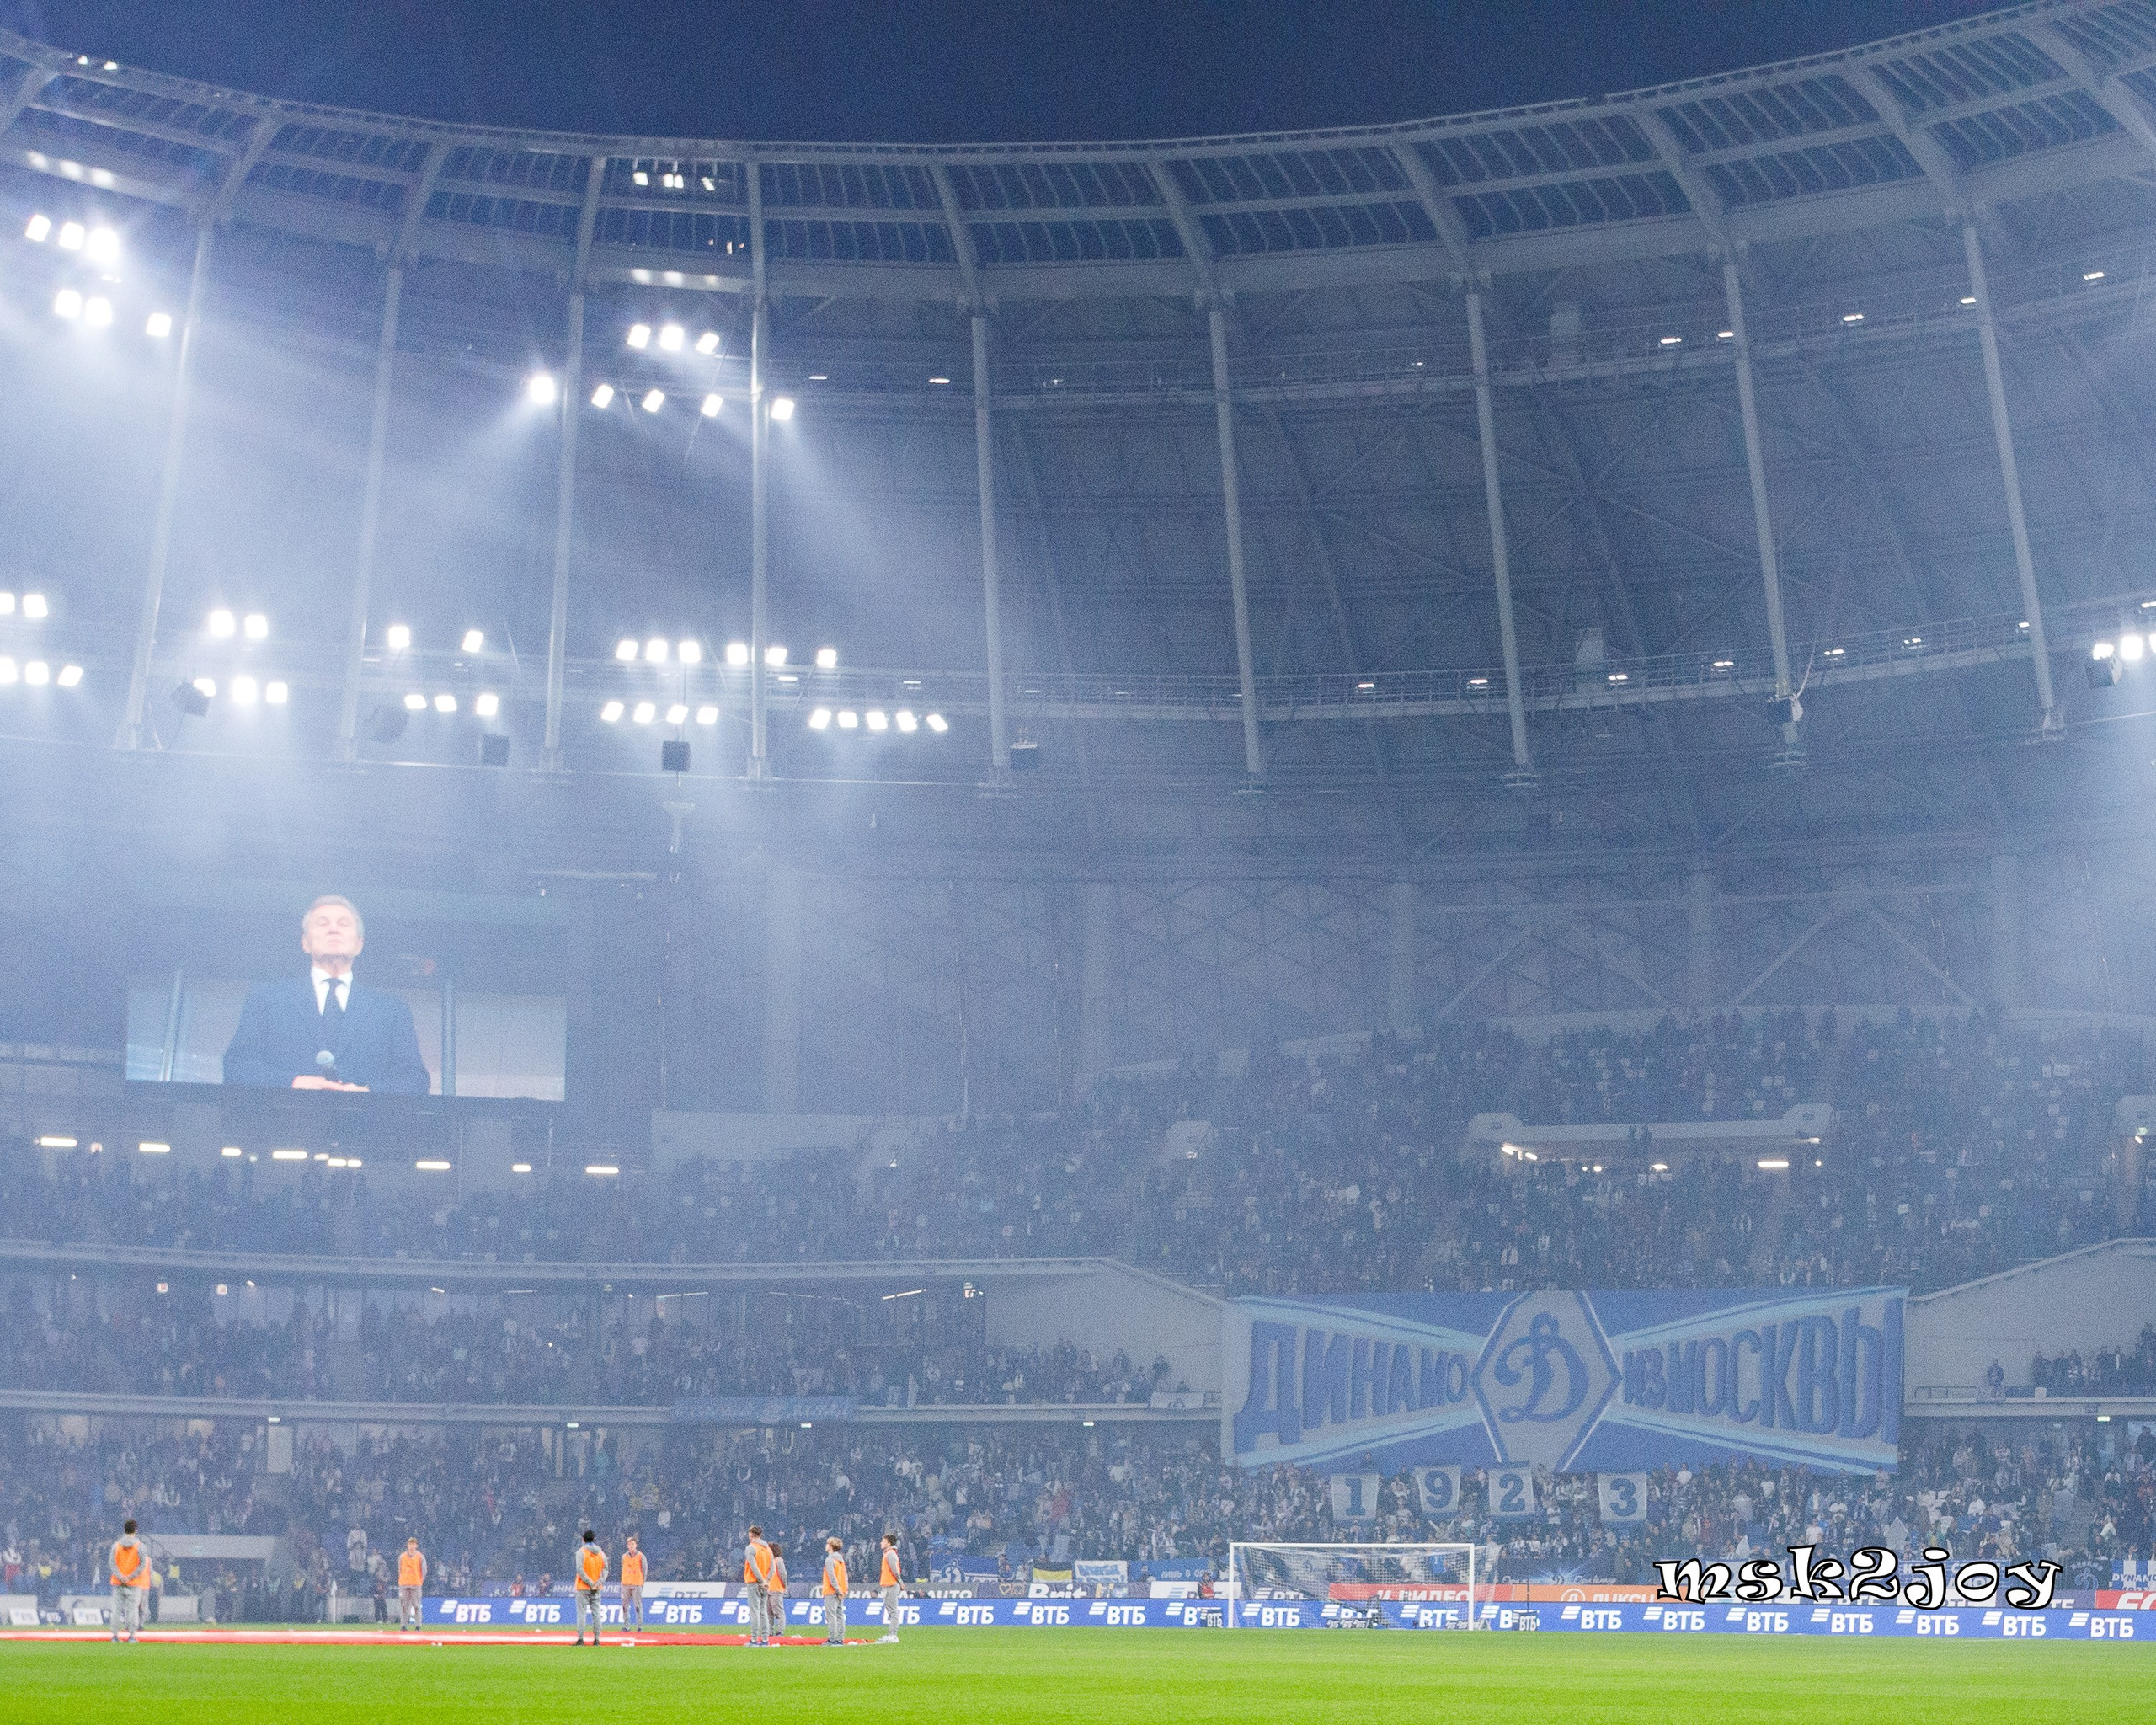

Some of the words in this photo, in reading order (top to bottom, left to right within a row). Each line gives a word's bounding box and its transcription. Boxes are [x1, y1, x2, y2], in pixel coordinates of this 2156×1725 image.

[1233, 1320, 1469, 1455] ДИНАМО
[456, 1604, 491, 1622] ВТБ
[525, 1605, 560, 1622] ВТБ
[666, 1605, 702, 1623] ВТБ
[957, 1606, 994, 1624] ВТБ
[1032, 1606, 1069, 1625] ВТБ
[1107, 1606, 1145, 1625] ВТБ
[1262, 1607, 1300, 1626] ВТБ
[1581, 1610, 1621, 1629] ВТБ
[1663, 1611, 1705, 1630] ВТБ
[1747, 1612, 1789, 1632] ВТБ
[1519, 1616, 1536, 1632] ВТБ
[1831, 1613, 1873, 1633] ВТБ
[1917, 1615, 1959, 1635] ВТБ
[2003, 1616, 2046, 1636] ВТБ
[2091, 1617, 2134, 1637] ВТБ
